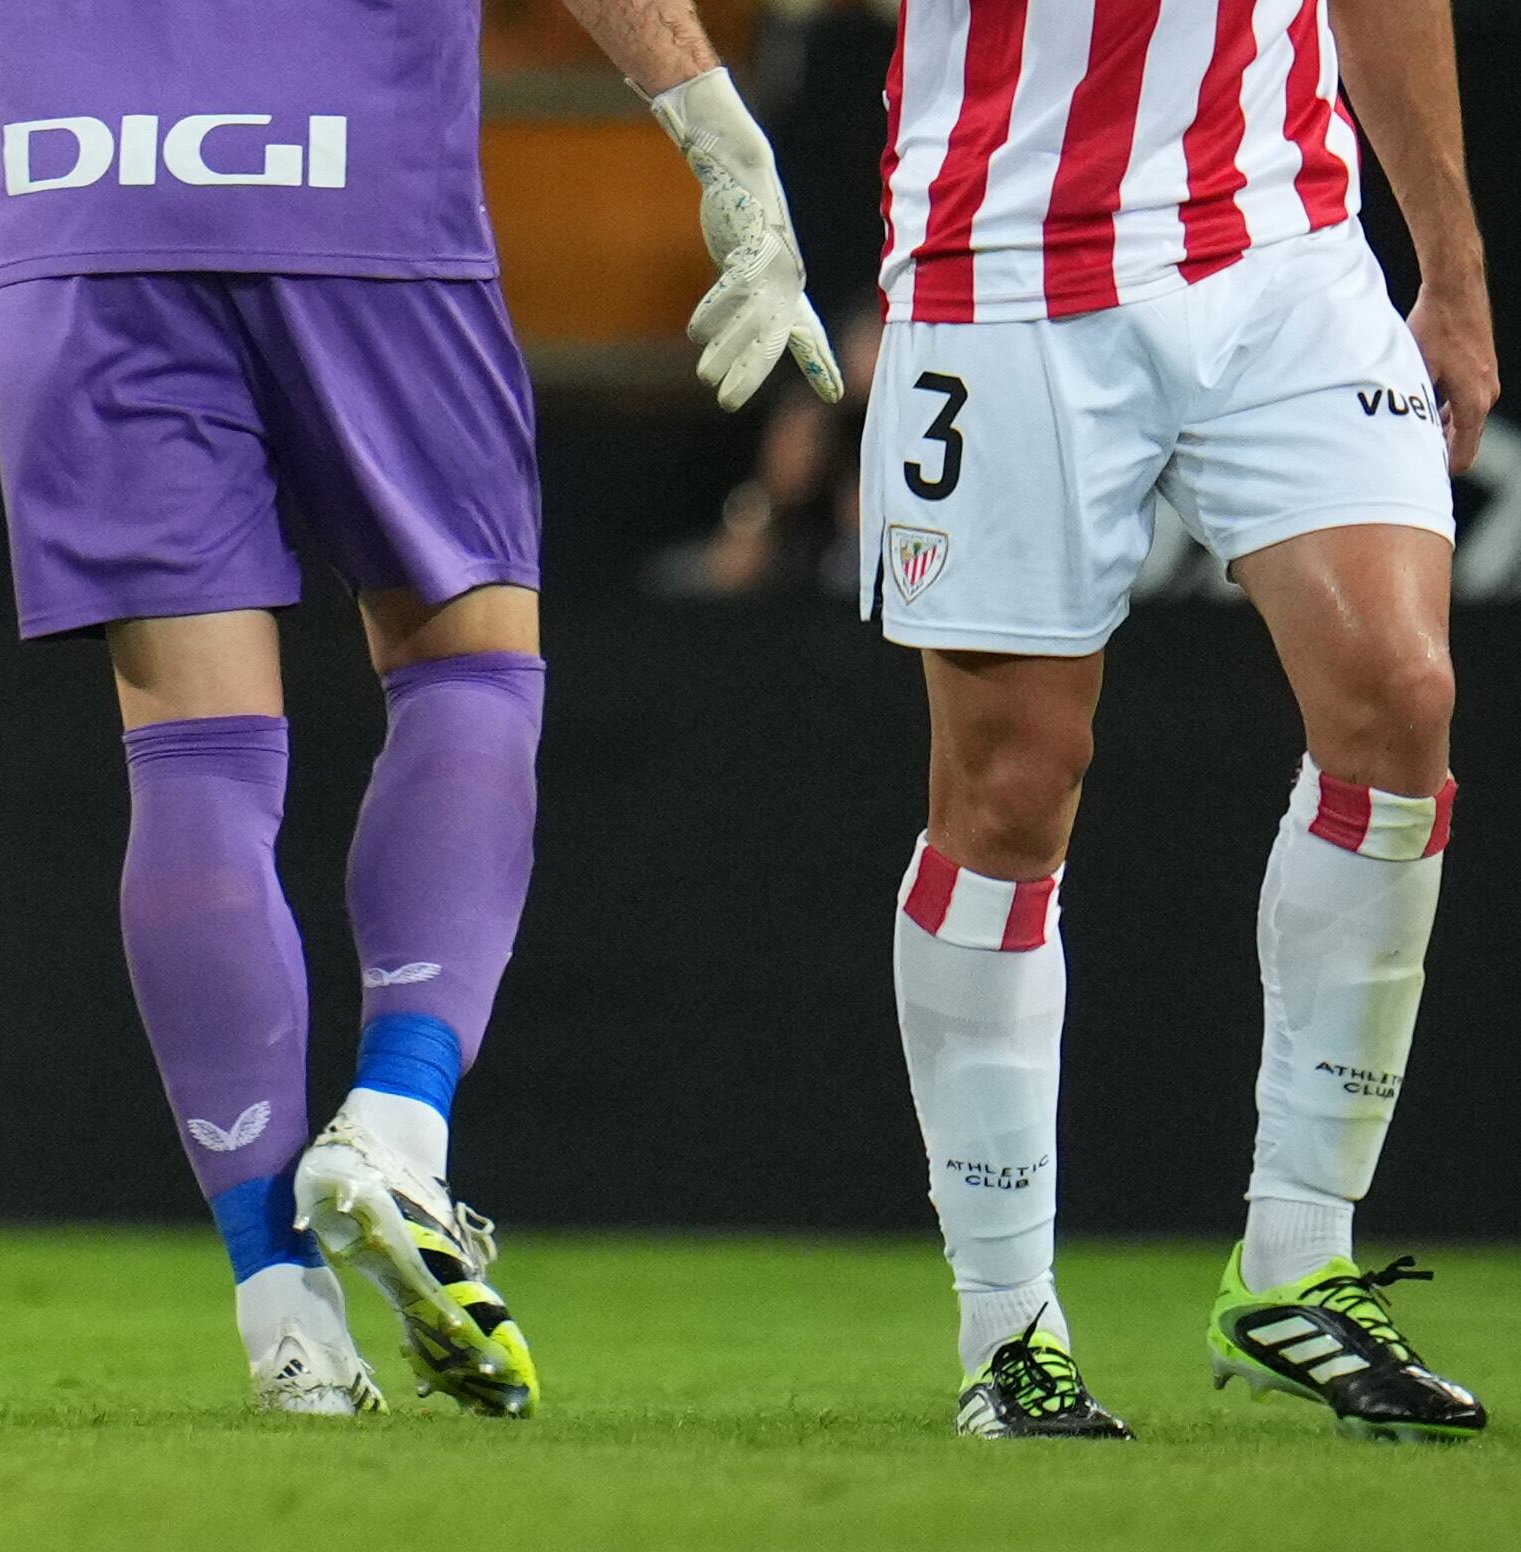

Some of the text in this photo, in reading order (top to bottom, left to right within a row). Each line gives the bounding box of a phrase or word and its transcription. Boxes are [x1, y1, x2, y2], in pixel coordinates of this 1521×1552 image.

[1, 114, 348, 196] DIGI
[902, 370, 969, 501] 3
[946, 1153, 1050, 1178] ATHLETIC
[964, 1174, 1031, 1190] CLUB
